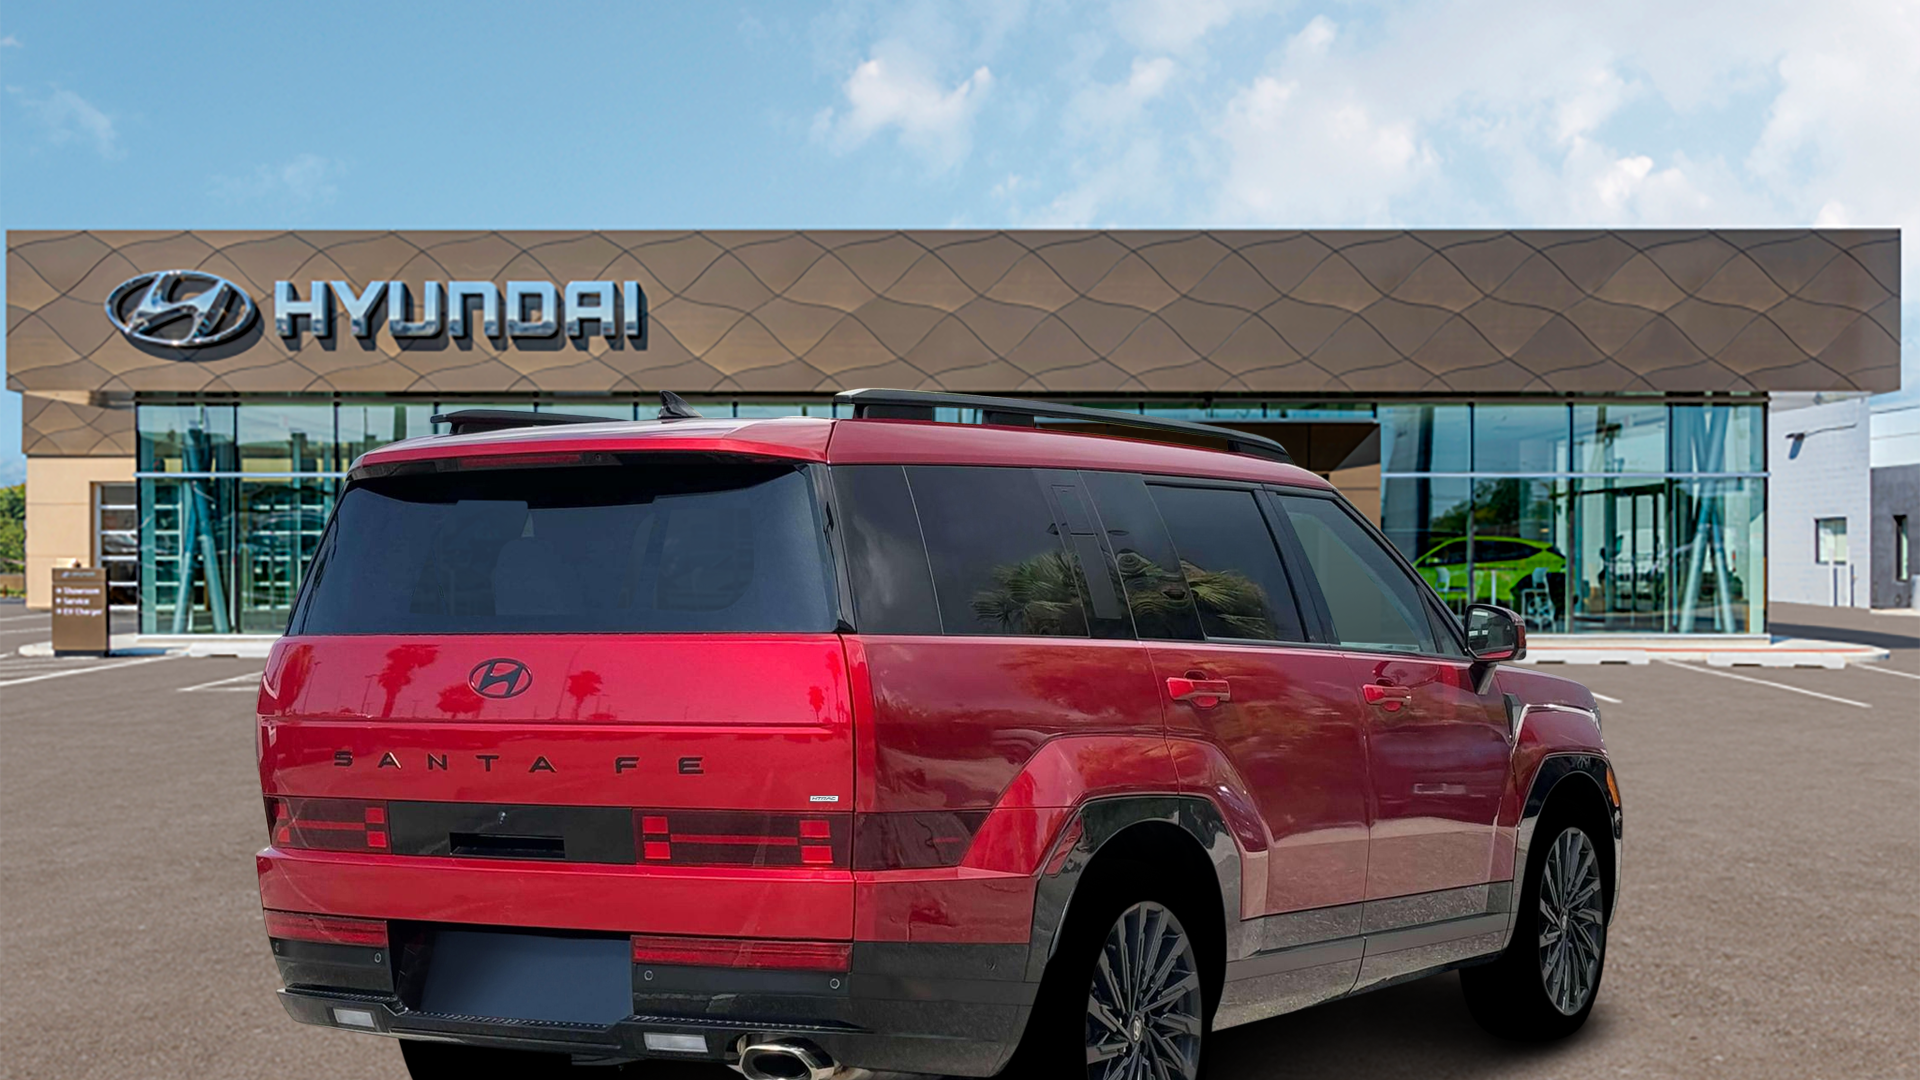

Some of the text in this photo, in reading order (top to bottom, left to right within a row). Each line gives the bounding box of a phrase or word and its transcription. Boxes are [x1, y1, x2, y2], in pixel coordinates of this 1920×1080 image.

[274, 280, 641, 339] HYUNDAI
[333, 751, 704, 775] SANTA FE
